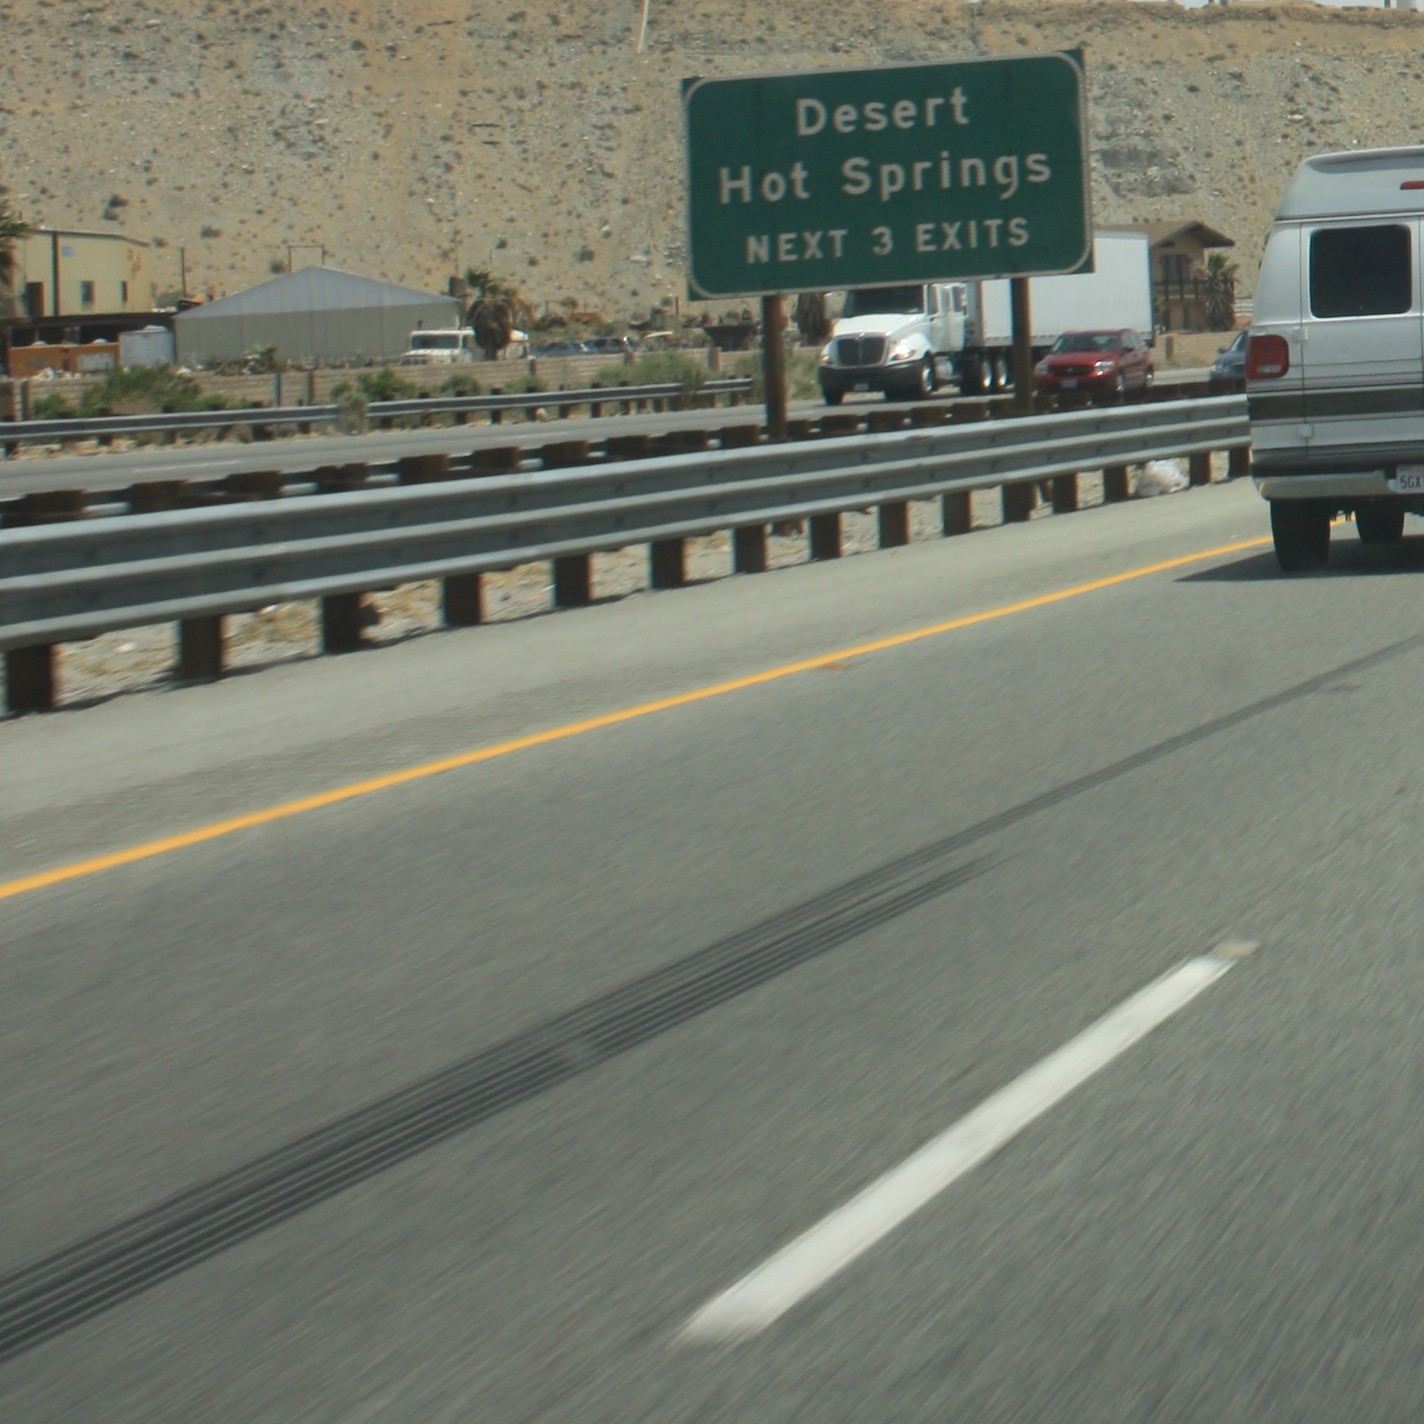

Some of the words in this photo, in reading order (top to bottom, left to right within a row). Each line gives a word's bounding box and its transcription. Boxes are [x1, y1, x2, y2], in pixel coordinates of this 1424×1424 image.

[796, 86, 968, 136] Desert
[719, 161, 809, 204] Hot
[841, 150, 1051, 201] Springs
[746, 228, 848, 264] NEXT
[872, 226, 894, 256] 3
[915, 216, 1029, 252] EXITS
